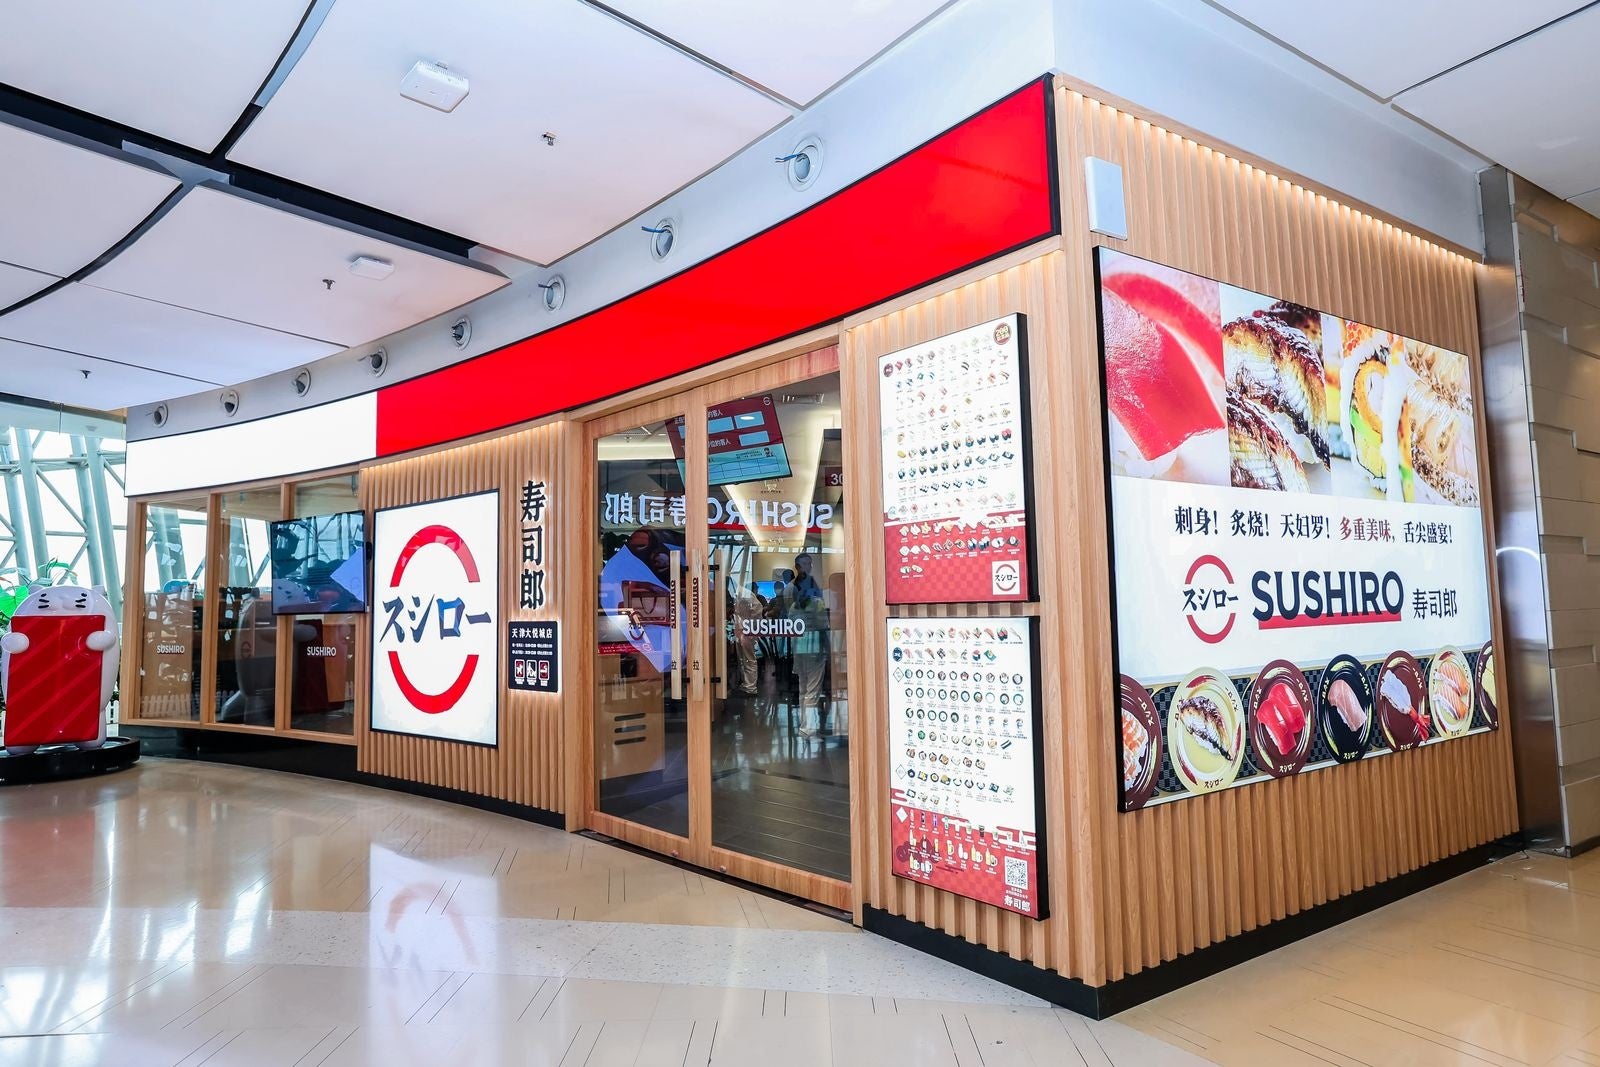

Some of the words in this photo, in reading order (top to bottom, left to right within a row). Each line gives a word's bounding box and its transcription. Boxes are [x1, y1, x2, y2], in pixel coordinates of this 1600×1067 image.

[520, 480, 546, 610] 寿司郎
[1182, 587, 1239, 612] スシロー
[1252, 570, 1404, 621] SUSHIRO
[1412, 588, 1458, 620] 寿司郎
[378, 594, 492, 644] スシロー
[512, 628, 552, 638] 天津大悦城店
[742, 618, 806, 635] SUSHIRO
[156, 644, 184, 654] SUSHIRO
[306, 646, 336, 656] SUSHIRO
[1279, 762, 1296, 773] スシロー
[1204, 778, 1224, 788] スシロー
[1004, 895, 1030, 912] 寿司郎
